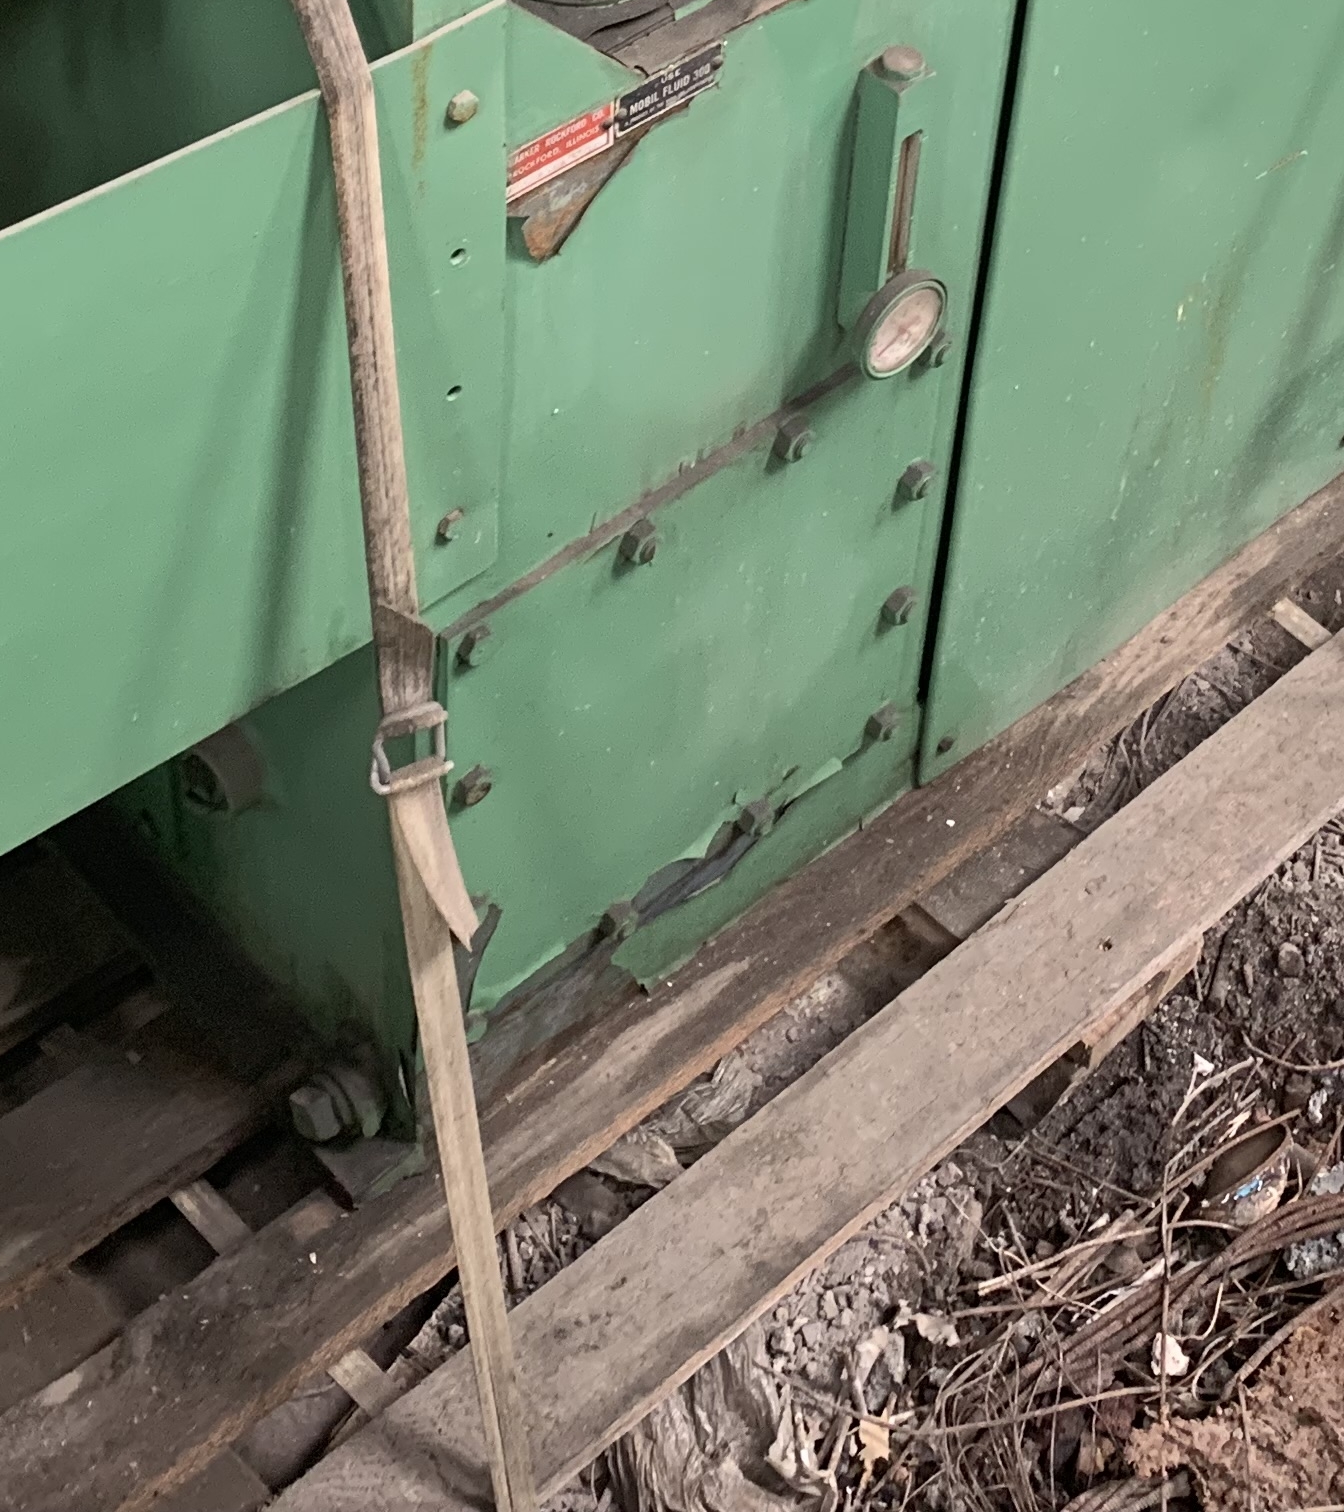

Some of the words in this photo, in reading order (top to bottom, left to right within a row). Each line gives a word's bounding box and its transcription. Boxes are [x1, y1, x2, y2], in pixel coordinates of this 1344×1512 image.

[629, 91, 660, 116] MOBIL
[662, 74, 691, 98] FLUID
[692, 62, 712, 82] 300
[660, 68, 682, 84] USE
[544, 118, 588, 148] ROCKFORD
